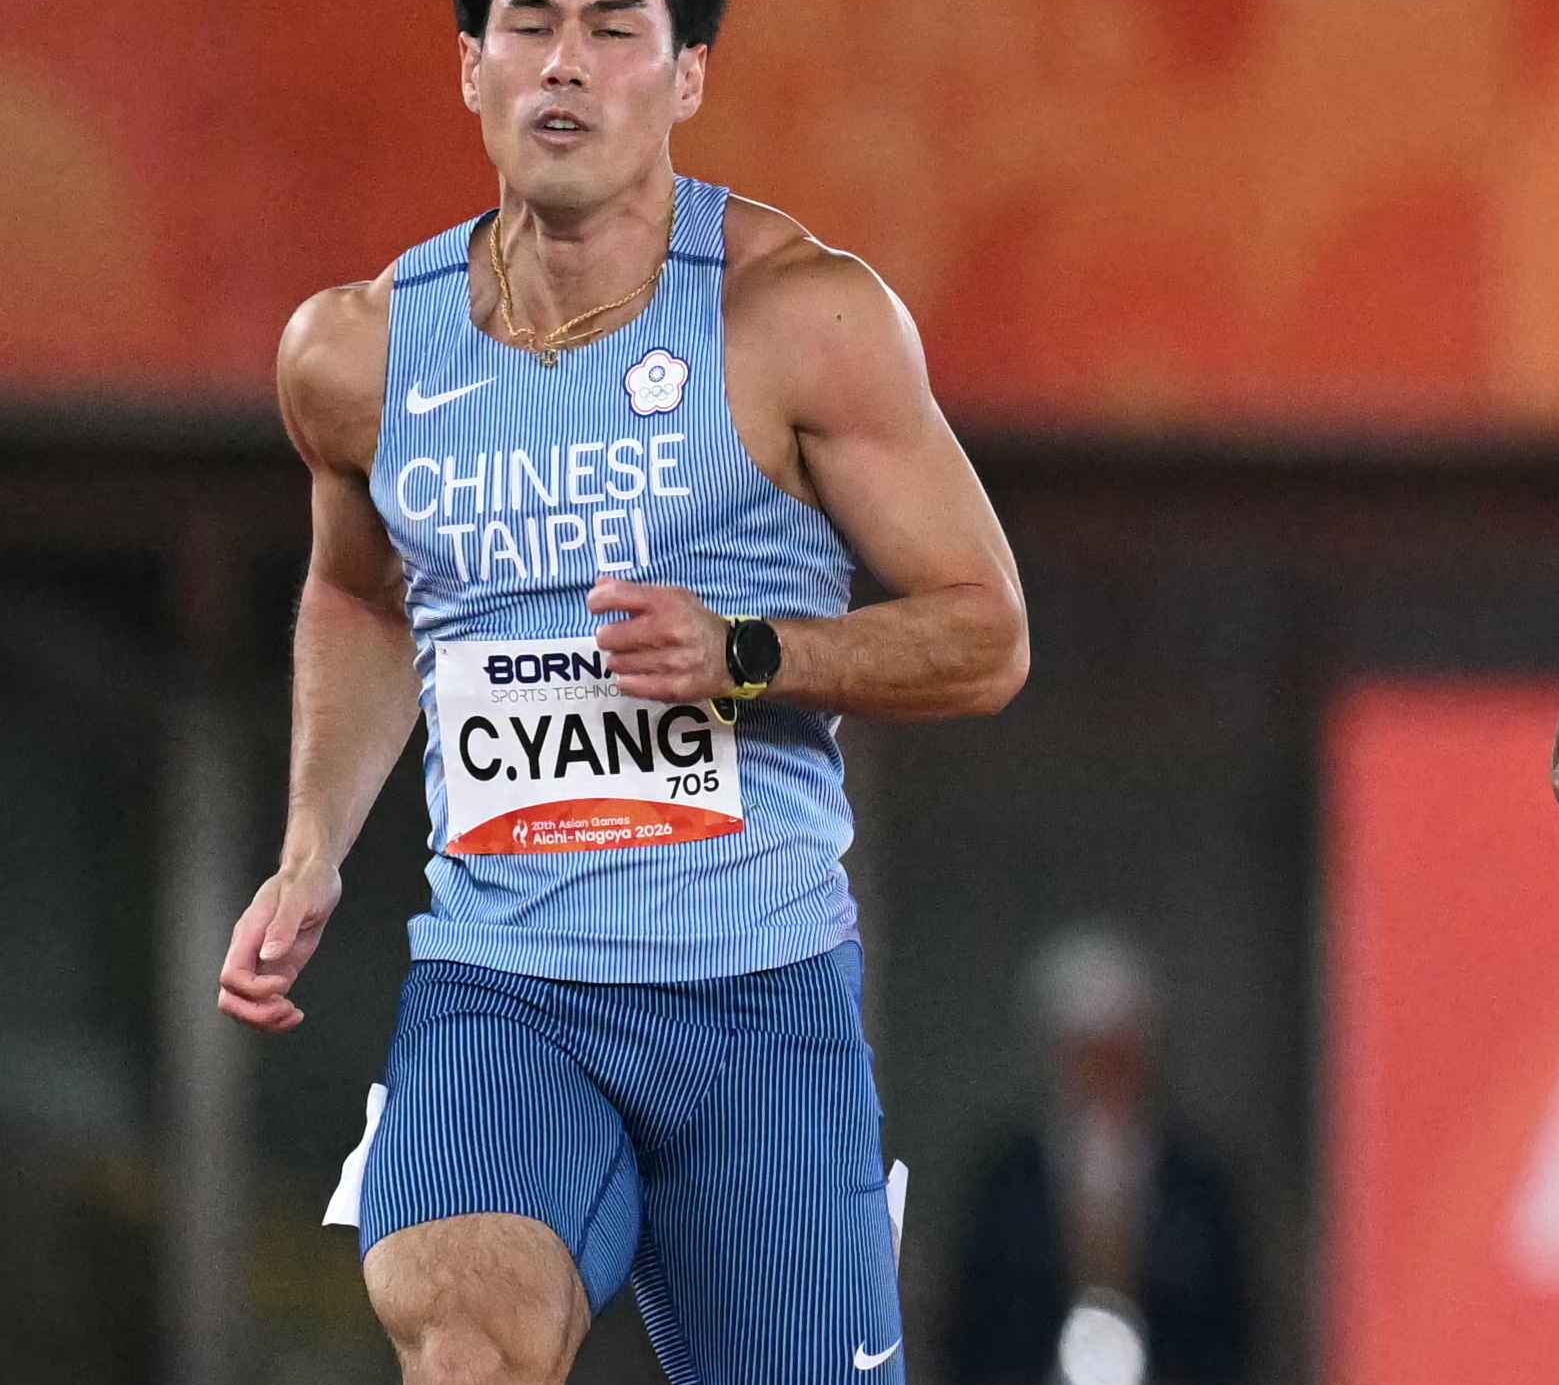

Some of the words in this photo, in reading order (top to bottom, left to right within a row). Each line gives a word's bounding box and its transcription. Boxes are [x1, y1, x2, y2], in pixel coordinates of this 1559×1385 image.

[397, 433, 691, 521] CHINESE
[437, 507, 651, 582] TAIPEI
[483, 650, 616, 684] BORN
[491, 687, 547, 703] SPORTS
[552, 683, 626, 701] TECHNO
[459, 705, 713, 781] C.YANG
[666, 769, 720, 799] 705
[531, 820, 555, 831] 20th
[559, 819, 589, 829] Asian
[591, 816, 630, 827] Games
[533, 829, 632, 845] Aichi-Nagoya
[635, 824, 673, 837] 2026
